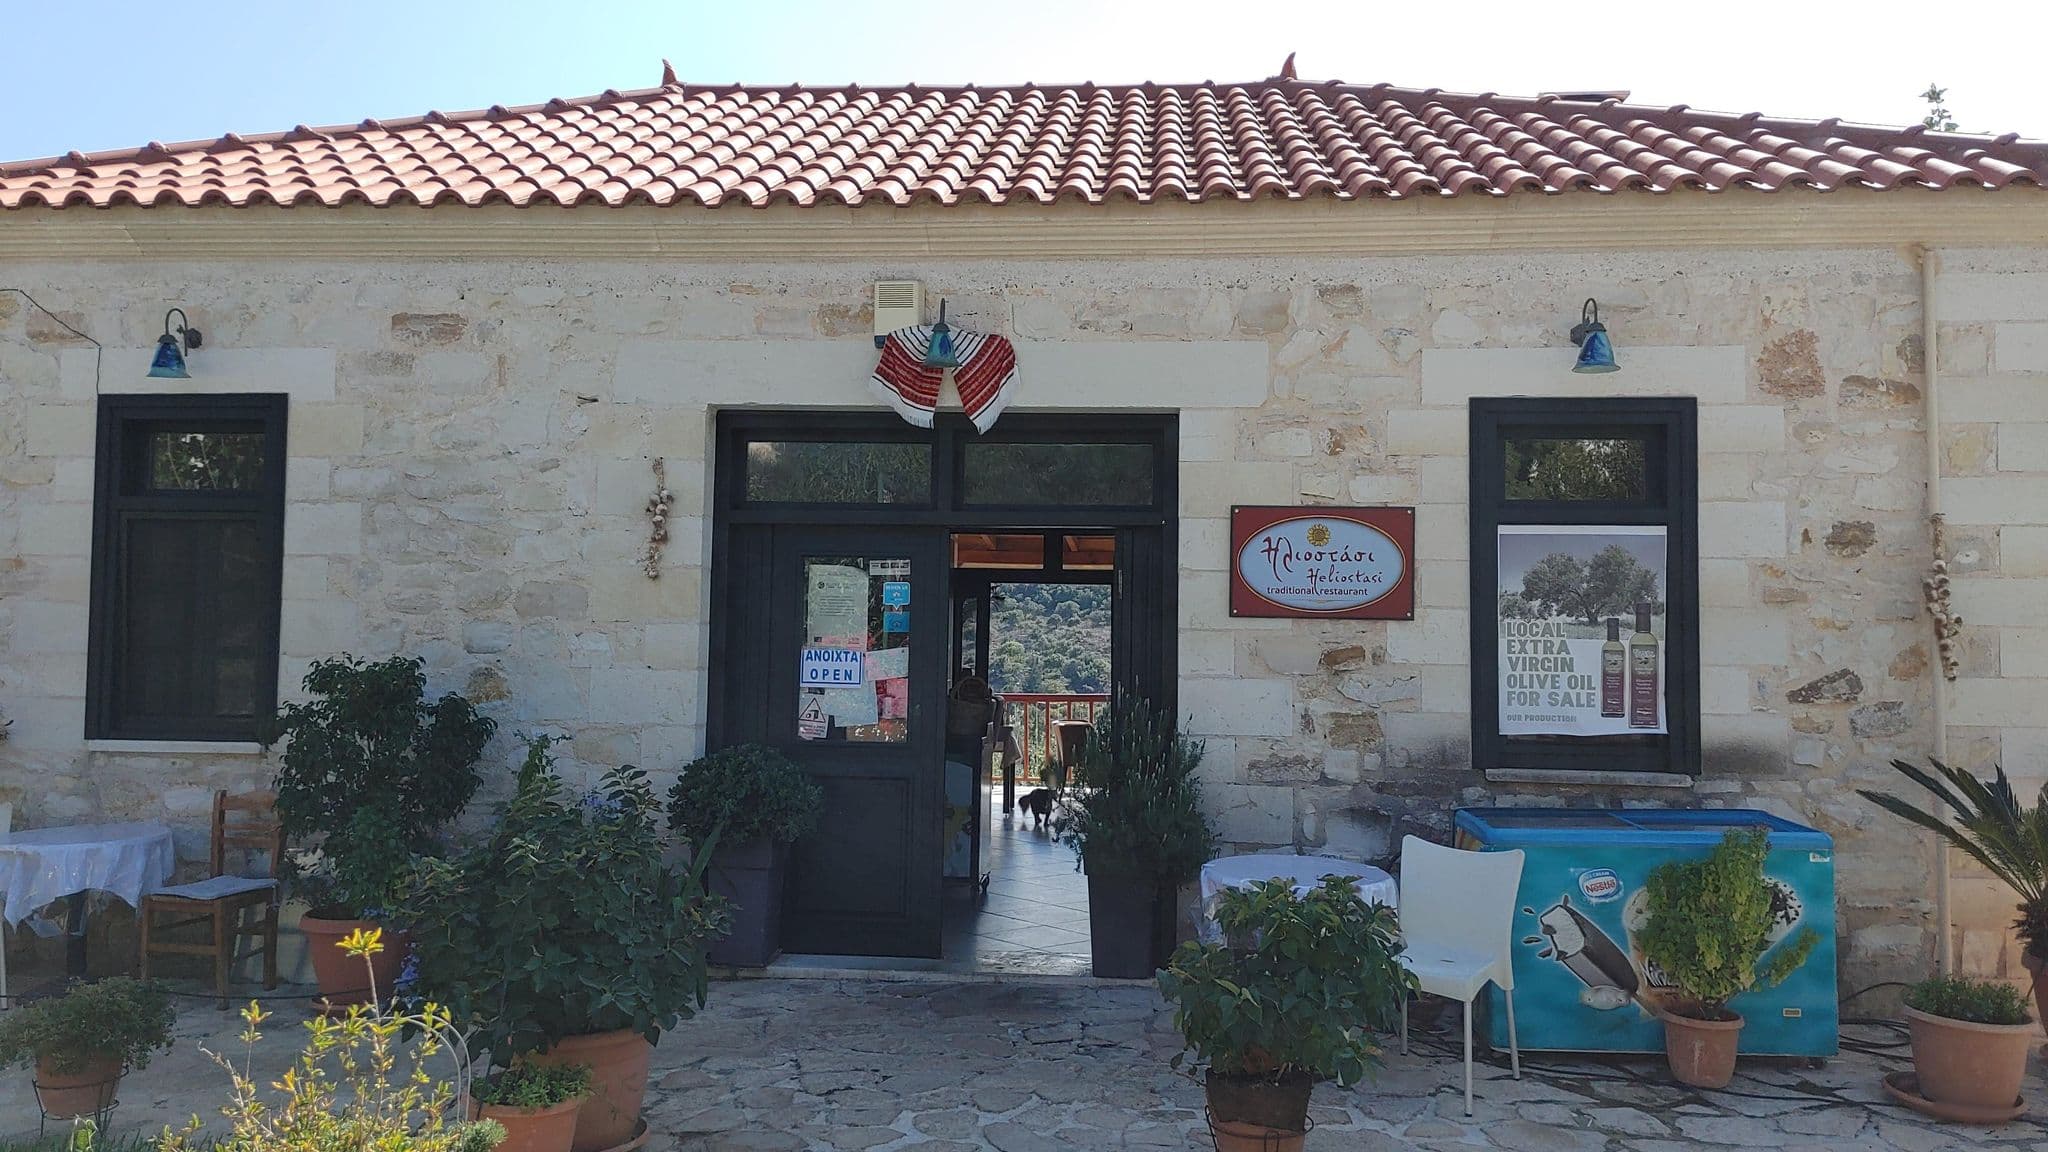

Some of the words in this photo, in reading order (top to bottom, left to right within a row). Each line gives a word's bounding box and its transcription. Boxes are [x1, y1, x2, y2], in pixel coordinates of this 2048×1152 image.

[1260, 536, 1375, 582] Ηλιοστάσι
[1307, 564, 1384, 595] Heliostasi
[1267, 586, 1314, 596] traditional
[1319, 587, 1368, 596] restaurant
[1506, 621, 1566, 638] LOCAL
[1506, 639, 1571, 655] EXTRA
[805, 650, 859, 663] ΑΝΟΙΧΤΑ
[1507, 656, 1575, 673] VIRGIN
[810, 668, 853, 681] OPEN
[1506, 673, 1560, 690] OLIVE
[1567, 674, 1596, 690] OIL
[1506, 690, 1541, 707] FOR
[1547, 691, 1596, 708] SALE
[1506, 714, 1522, 722] OUR
[1524, 714, 1577, 723] PRODUCTION
